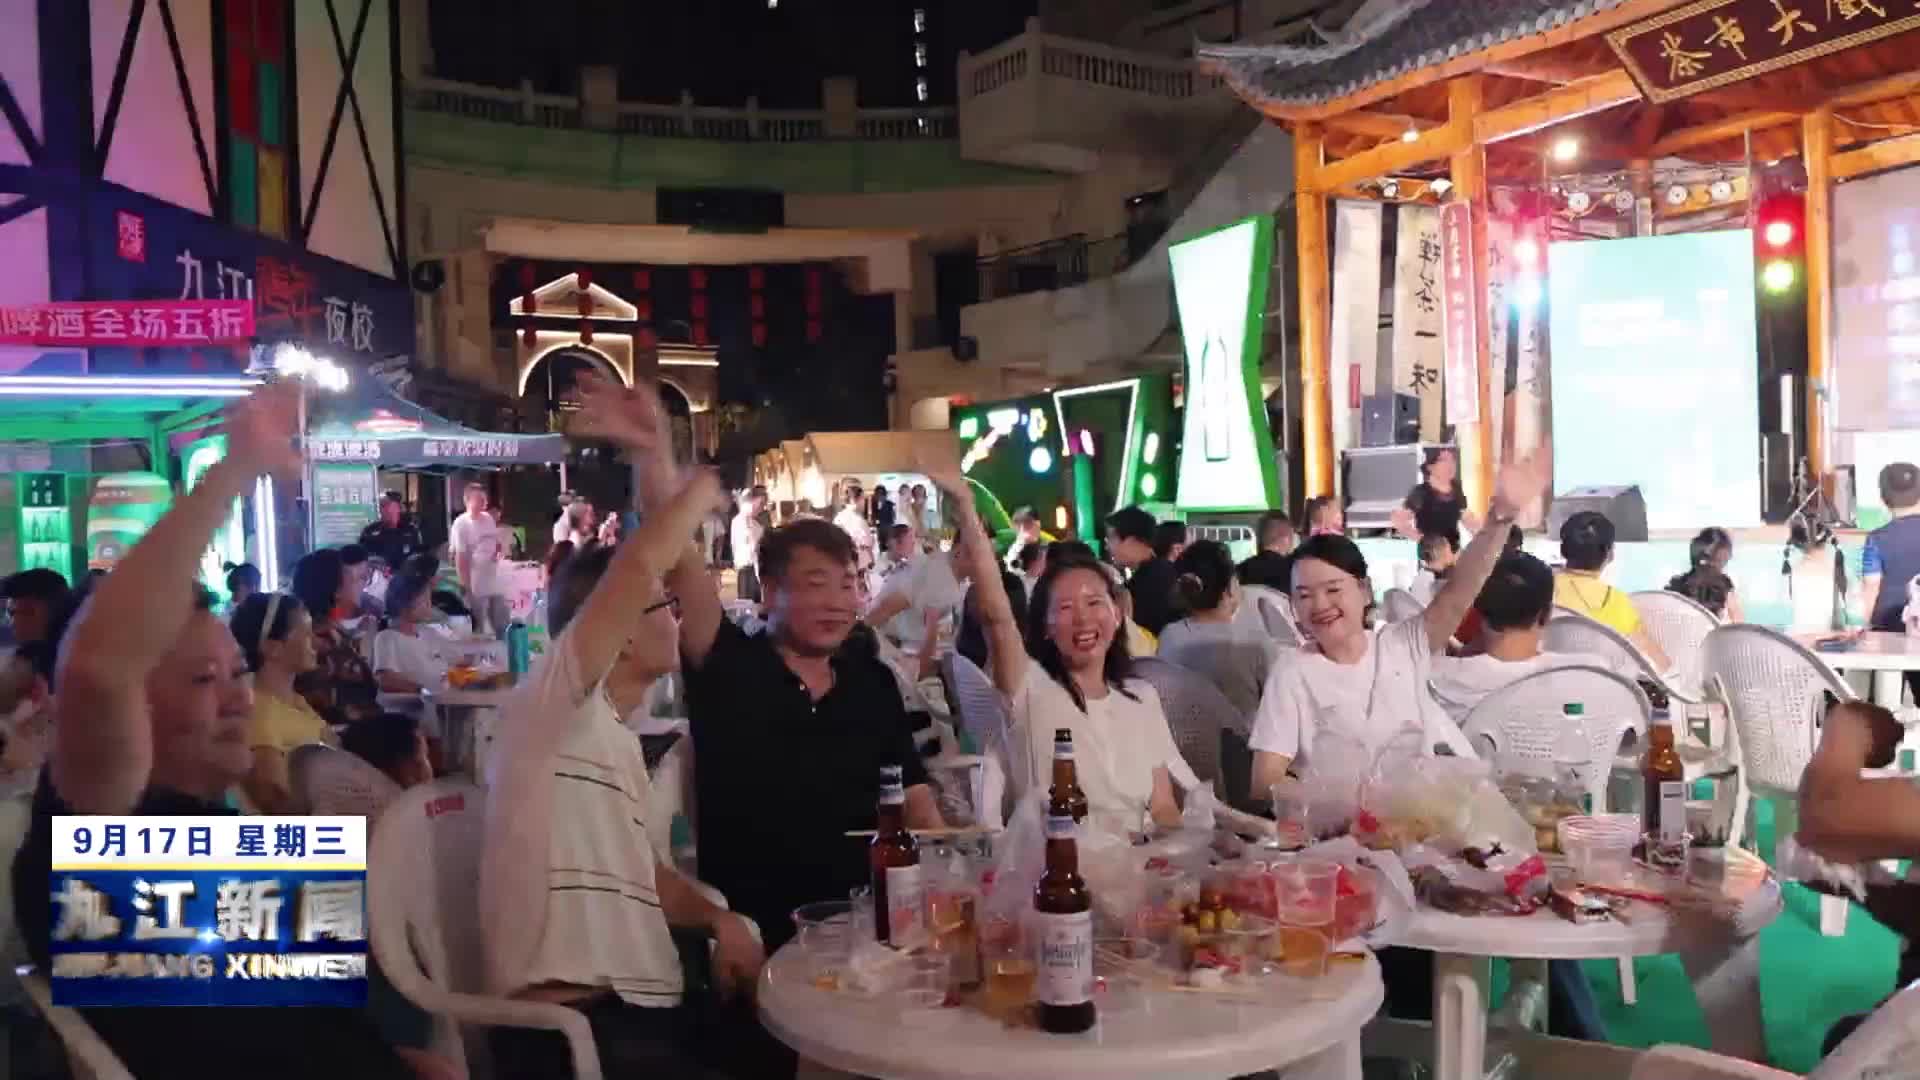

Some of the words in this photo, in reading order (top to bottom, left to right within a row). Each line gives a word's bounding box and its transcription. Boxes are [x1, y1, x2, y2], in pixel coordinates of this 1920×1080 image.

[0, 308, 244, 340] 啤酒全场五折
